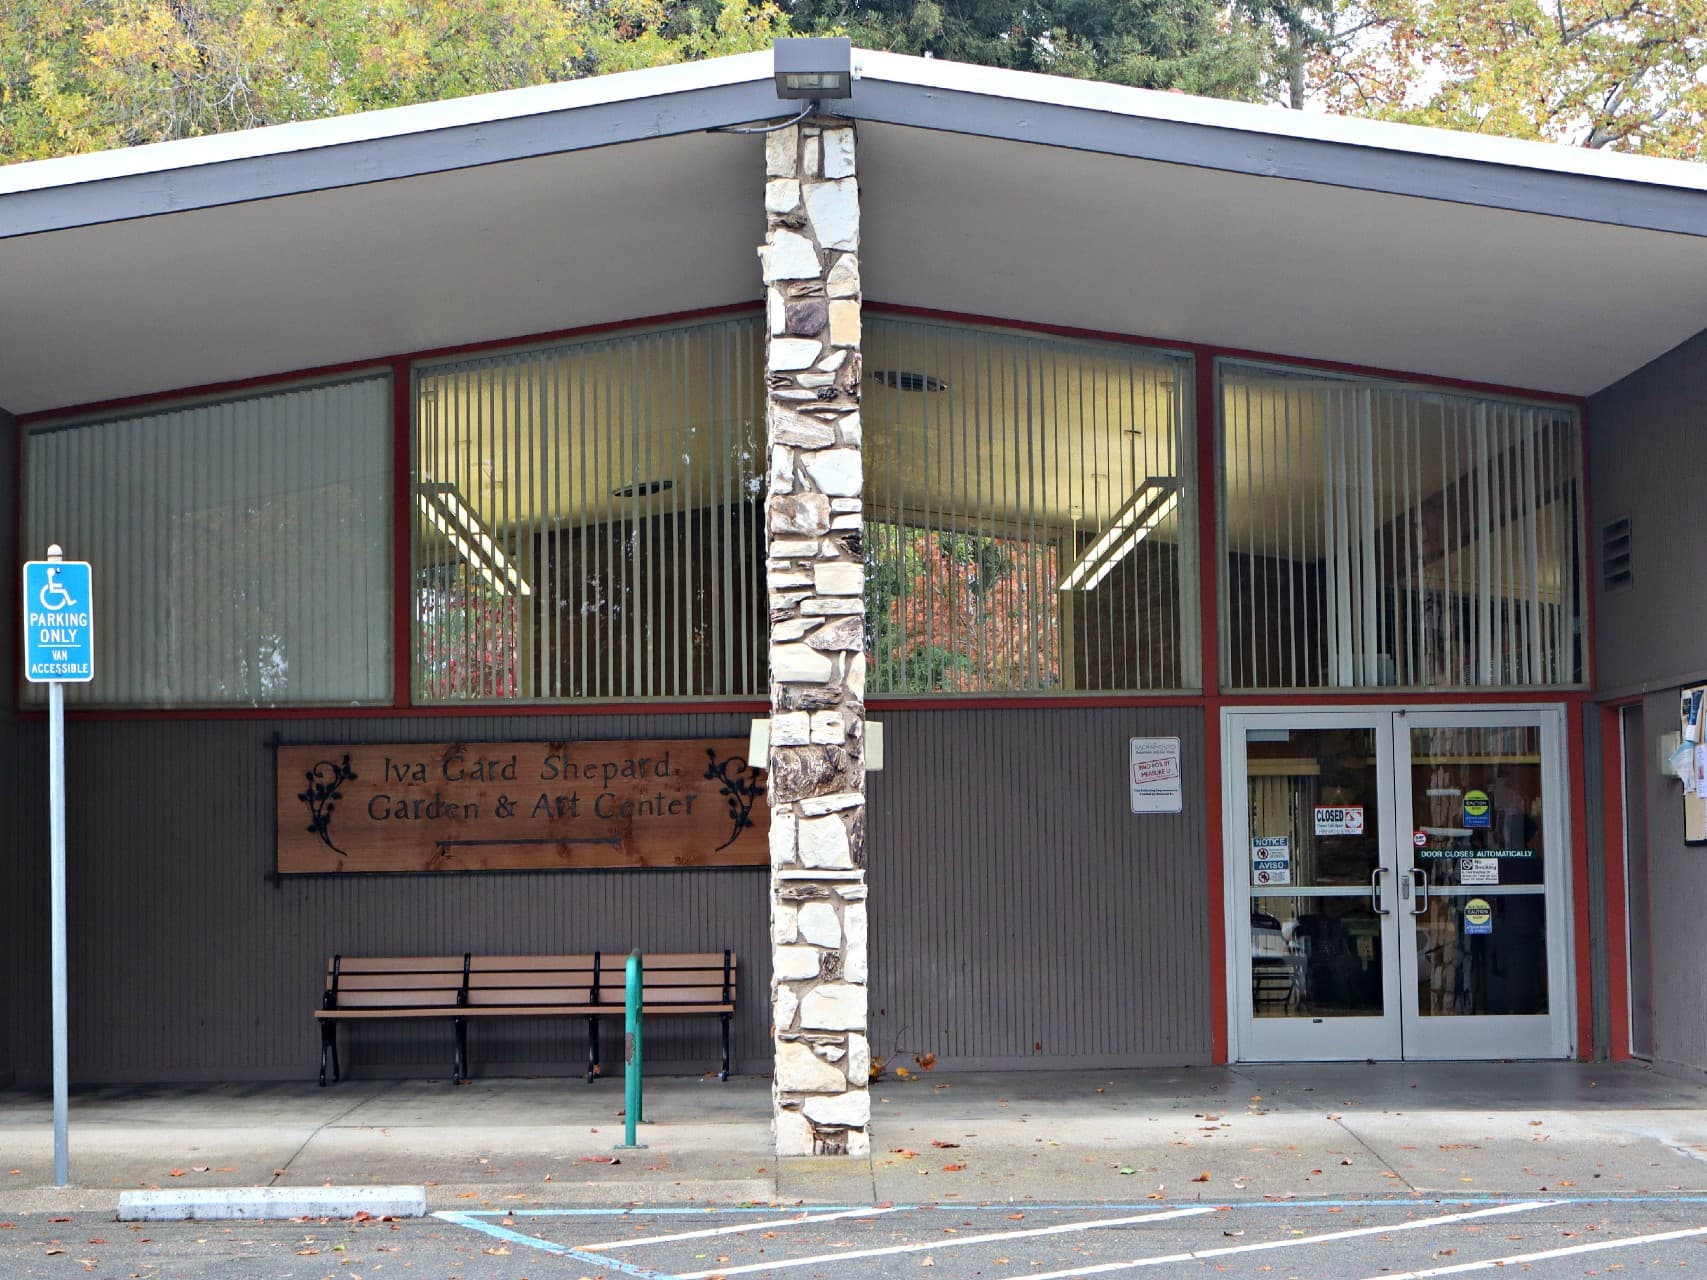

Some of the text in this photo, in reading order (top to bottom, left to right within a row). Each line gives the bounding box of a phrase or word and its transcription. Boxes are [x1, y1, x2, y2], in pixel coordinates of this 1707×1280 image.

[30, 612, 88, 627] PARKING
[40, 629, 78, 643] ONLY
[51, 650, 68, 661] VAN
[31, 663, 89, 674] ACCESSIBLE
[384, 751, 670, 789] Iva Gard Shepard
[367, 791, 697, 821] Garden & Art Center
[1316, 809, 1344, 822] CLOSED
[1255, 838, 1286, 846] NOTICE
[1421, 850, 1532, 858] DOOR CLOSES AUTOMATICALLY
[1259, 861, 1284, 869] AVISO
